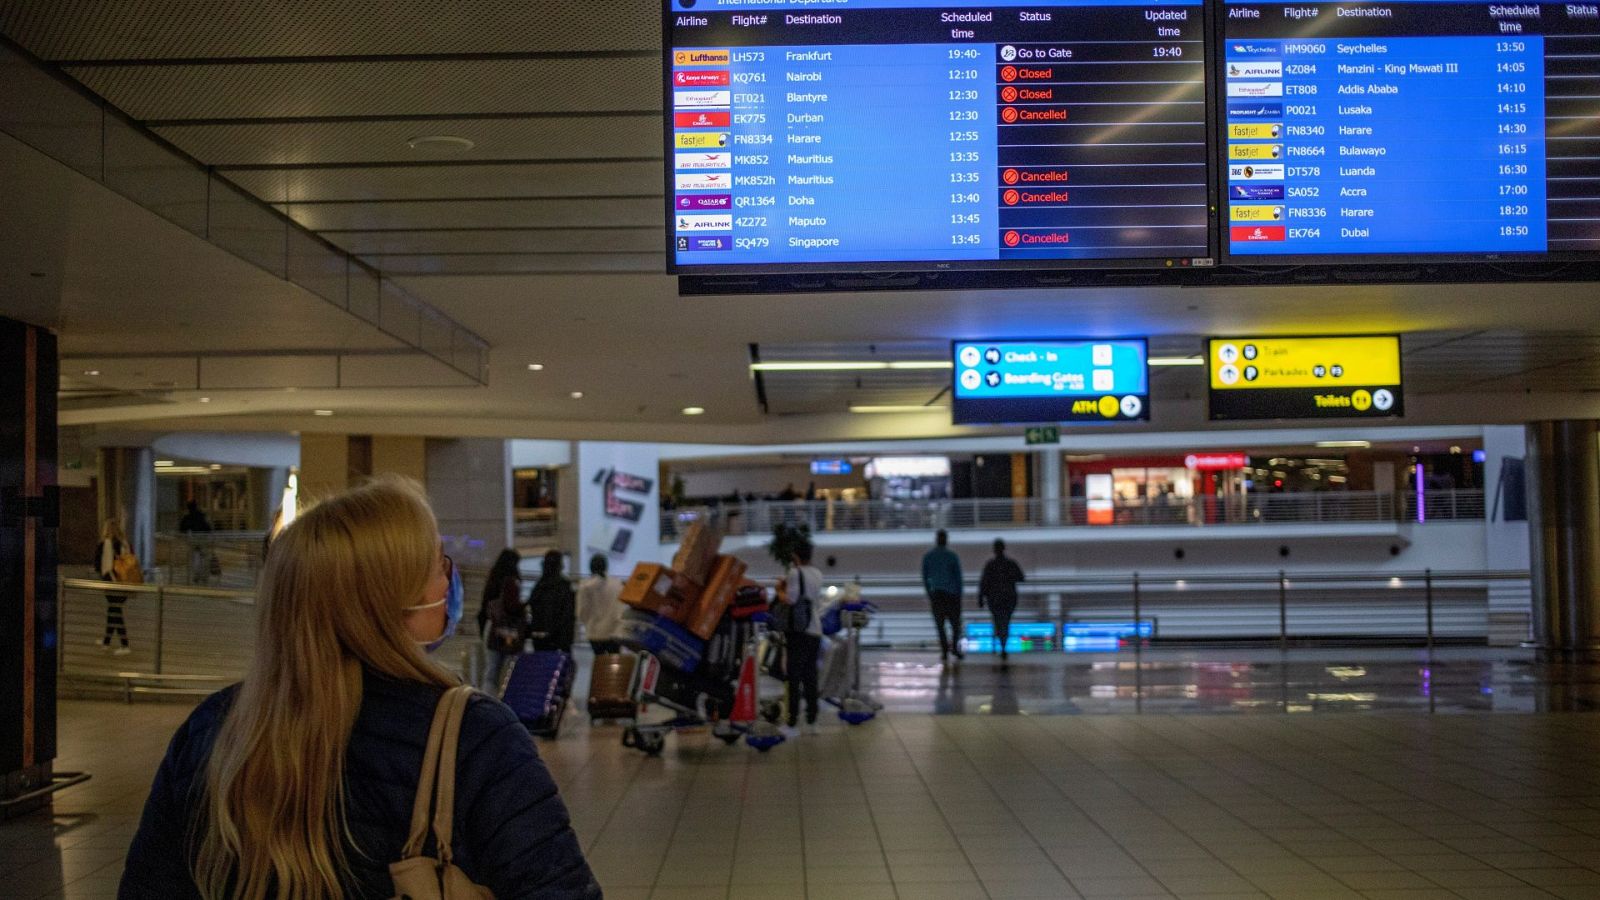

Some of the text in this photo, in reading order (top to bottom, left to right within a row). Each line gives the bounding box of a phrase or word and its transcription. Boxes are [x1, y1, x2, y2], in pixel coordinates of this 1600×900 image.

[1146, 10, 1186, 20] Updated
[1229, 8, 1259, 18] Airline
[1285, 7, 1318, 19] Flight#
[1337, 6, 1392, 18] Destination
[1489, 5, 1540, 17] Scheduled
[1566, 5, 1598, 16] Status
[677, 17, 707, 25] Airline
[732, 15, 767, 26] Flight#
[786, 15, 841, 24] Destination
[942, 12, 992, 22] Scheduled
[1020, 12, 1051, 21] Status
[1158, 27, 1180, 35] time
[1500, 22, 1521, 31] time
[952, 29, 974, 38] time
[1153, 47, 1181, 57] 19:40
[1285, 43, 1326, 54] HM9060
[1337, 43, 1387, 54] Seychelles
[1496, 42, 1524, 52] 13:50
[733, 51, 764, 62] LH573
[786, 51, 832, 61] Frankfurt
[1019, 49, 1072, 58] Go to Gate
[1285, 64, 1316, 74] 4Z084
[1338, 64, 1374, 73] Manzini
[1385, 63, 1406, 75] King
[1409, 63, 1442, 73] Mswati
[1446, 63, 1458, 73] III
[1497, 62, 1525, 72] 14:05
[733, 72, 767, 84] KQ761
[787, 71, 821, 81] Nairobi
[949, 70, 977, 79] 12:10
[1019, 69, 1051, 79] Closed
[1285, 84, 1318, 95] ET808
[1338, 84, 1398, 94] Addis Ababa
[1497, 83, 1525, 92] 14:10
[733, 93, 765, 104] ET021
[787, 92, 827, 103] Blantyre
[949, 90, 977, 100] 12:30
[1020, 89, 1052, 99] Closed
[1287, 105, 1316, 115] P0021
[1339, 105, 1372, 114] Lusaka
[1498, 103, 1525, 113] 14:15
[734, 113, 766, 124] EK775
[787, 113, 823, 123] Durban
[949, 111, 978, 121] 12:30
[1020, 110, 1066, 119] Cancelled
[1287, 126, 1324, 136] FN8340
[1339, 125, 1372, 135] Harare
[1498, 124, 1526, 133] 14:30
[734, 133, 773, 145] FN8334
[788, 133, 821, 143] Harare
[950, 132, 978, 141] 12:55
[1287, 146, 1325, 157] FN8664
[1340, 146, 1386, 157] Bulawayo
[1499, 144, 1526, 154] 16:15
[734, 154, 768, 165] MK852
[788, 154, 833, 164] Mauritius
[950, 152, 979, 162] 13:35
[1288, 167, 1320, 176] DT578
[1340, 166, 1375, 176] Luanda
[1499, 165, 1527, 174] 16:30
[734, 175, 776, 186] MK852h
[788, 174, 833, 185] Mauritius
[950, 173, 979, 182] 13:35
[1021, 171, 1067, 181] Cancelled
[1288, 187, 1319, 197] SA052
[1340, 187, 1366, 196] Accra
[1499, 185, 1527, 195] 17:00
[735, 195, 775, 207] QR1364
[789, 195, 814, 205] Doha
[951, 193, 979, 204] 13:40
[1021, 192, 1068, 202] Cancelled
[1289, 207, 1326, 217] FN8336
[1341, 207, 1373, 217] Harare
[1499, 206, 1528, 215] 18:20
[735, 216, 767, 227] 4Z272
[789, 216, 826, 227] Maputo
[951, 214, 979, 224] 13:45
[1289, 228, 1320, 238] EK764
[1341, 227, 1369, 237] Dubai
[1500, 226, 1528, 236] 18:50
[789, 236, 839, 248] Singapore
[952, 235, 980, 244] 13:45
[1021, 233, 1069, 243] Cancelled
[736, 238, 769, 249] SQ479
[1005, 352, 1037, 362] Check
[1046, 352, 1058, 362] In
[1005, 373, 1051, 386] Boarding
[1053, 373, 1084, 383] Gates
[1314, 395, 1351, 408] Toilets
[1071, 401, 1098, 414] ATM
